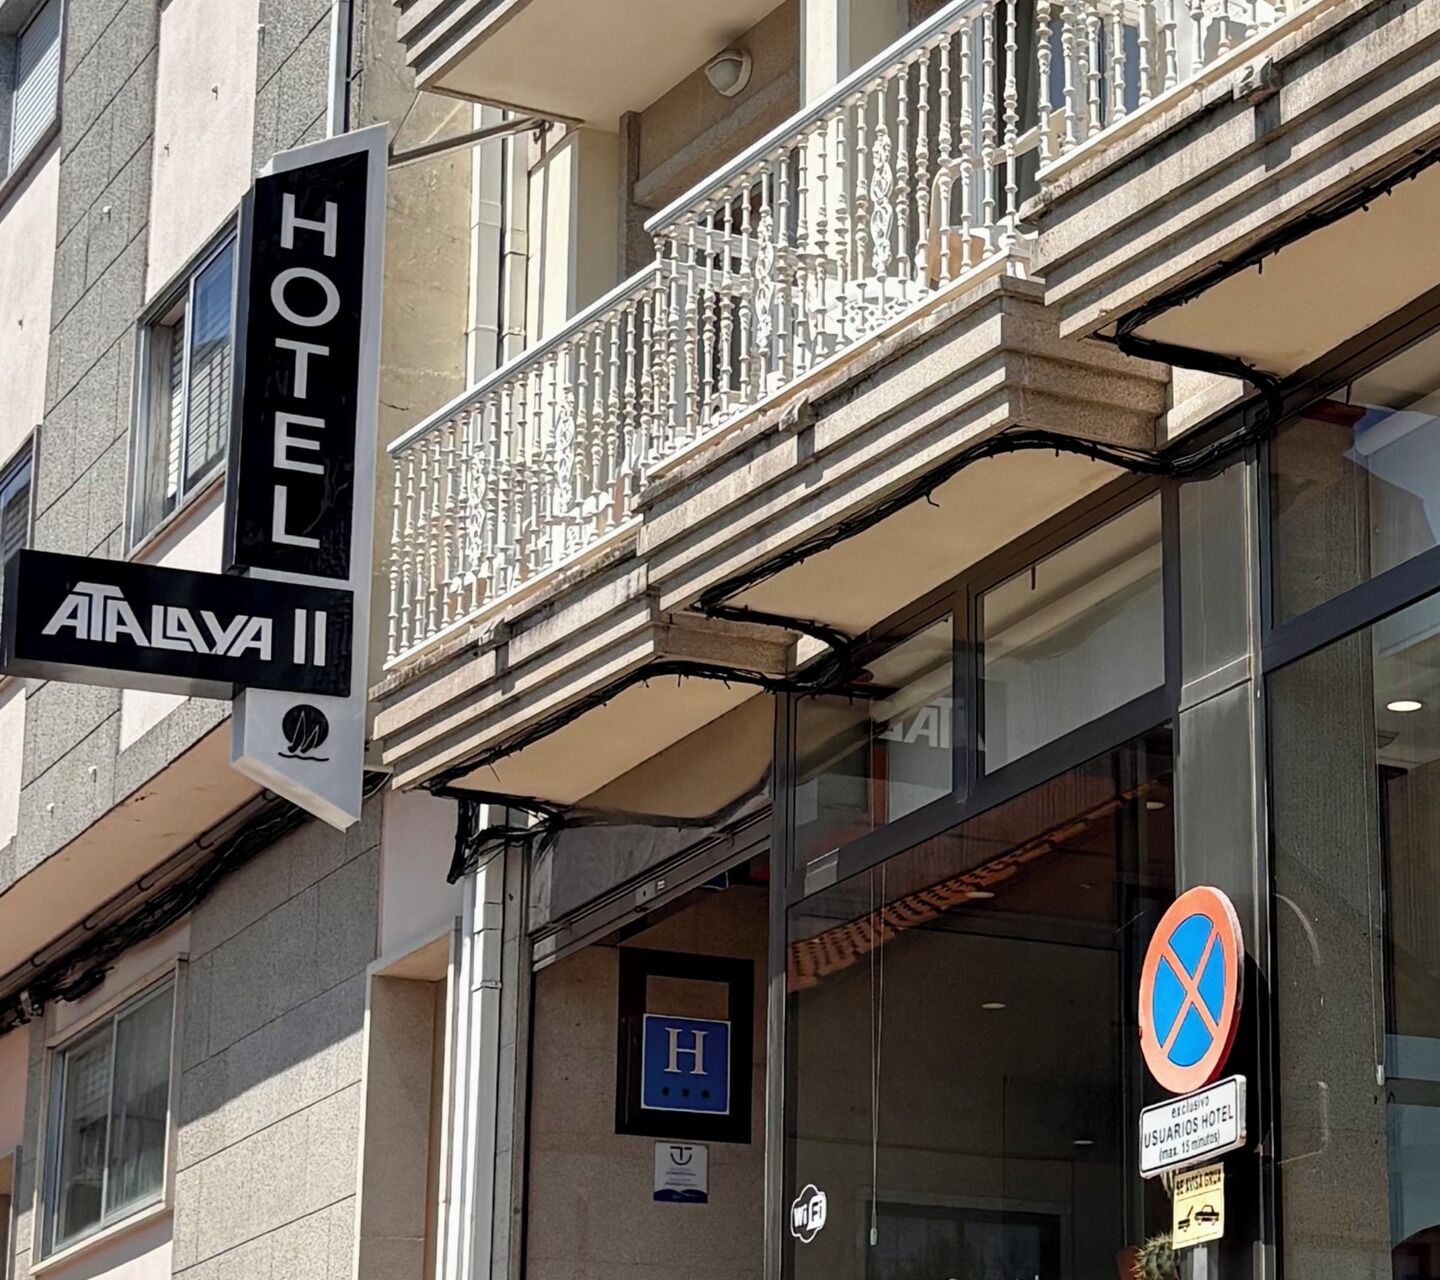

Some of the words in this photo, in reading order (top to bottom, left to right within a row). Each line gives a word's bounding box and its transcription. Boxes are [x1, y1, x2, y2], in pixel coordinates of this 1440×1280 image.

[270, 193, 340, 549] HOTEL
[41, 581, 274, 661] ATALAYA
[293, 608, 327, 667] II
[663, 1026, 708, 1077] H
[1144, 1117, 1199, 1148] USUARIOS
[1202, 1104, 1234, 1130] HOTEL
[1172, 1096, 1210, 1118] exclusivo
[1182, 1139, 1190, 1154] 15
